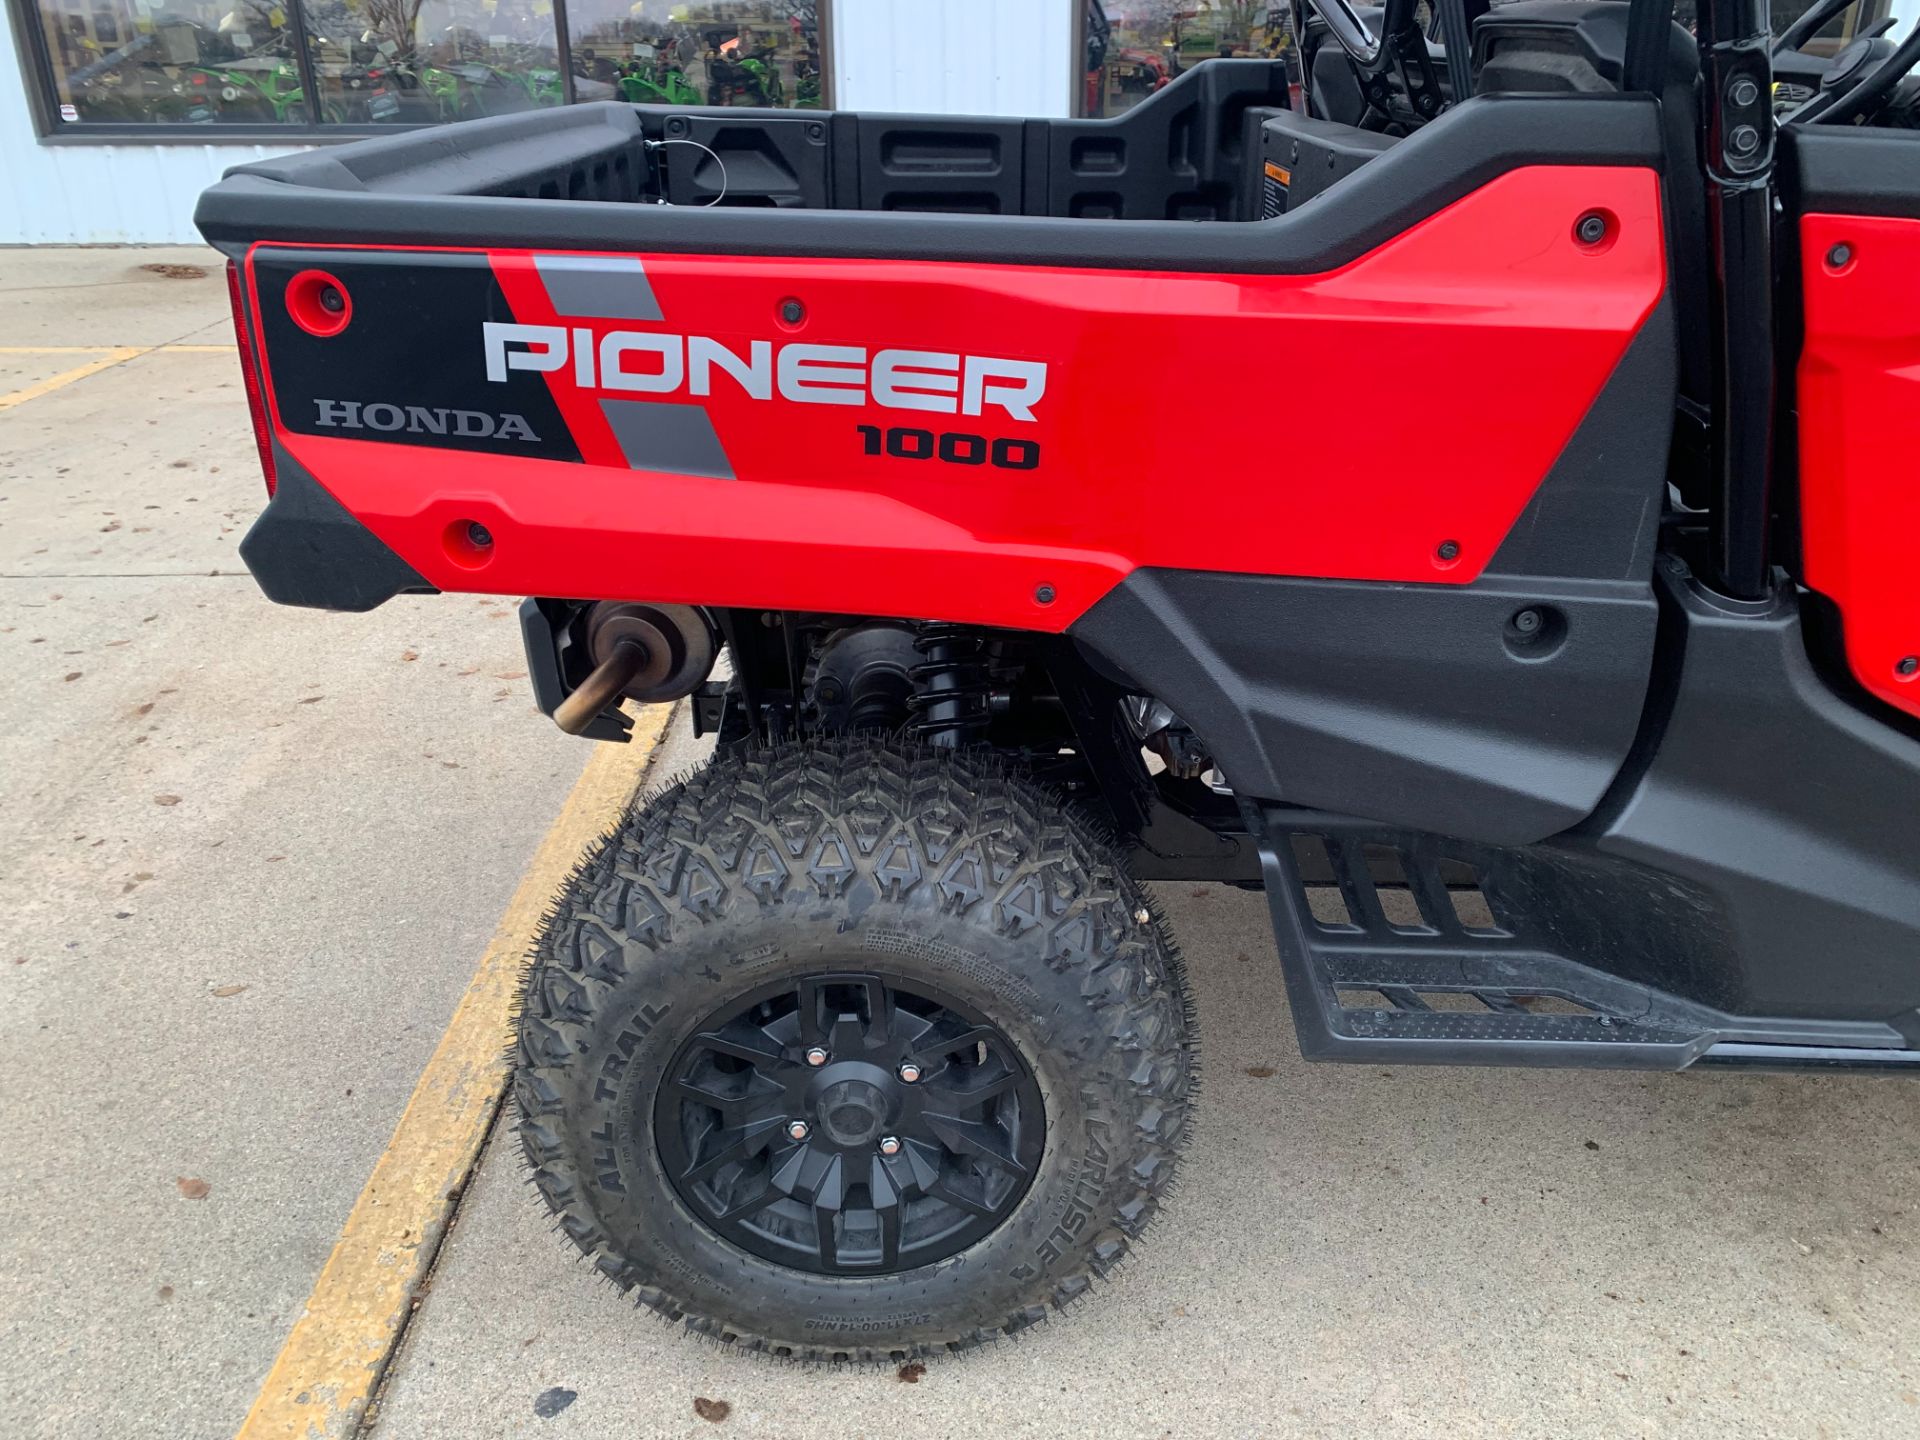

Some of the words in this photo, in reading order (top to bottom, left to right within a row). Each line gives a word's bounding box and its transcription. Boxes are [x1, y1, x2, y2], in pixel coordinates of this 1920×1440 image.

[483, 322, 1047, 421] PIONEER
[313, 398, 542, 442] HONDA
[857, 425, 1041, 470] 1000
[1034, 1119, 1110, 1266] CARLISLE
